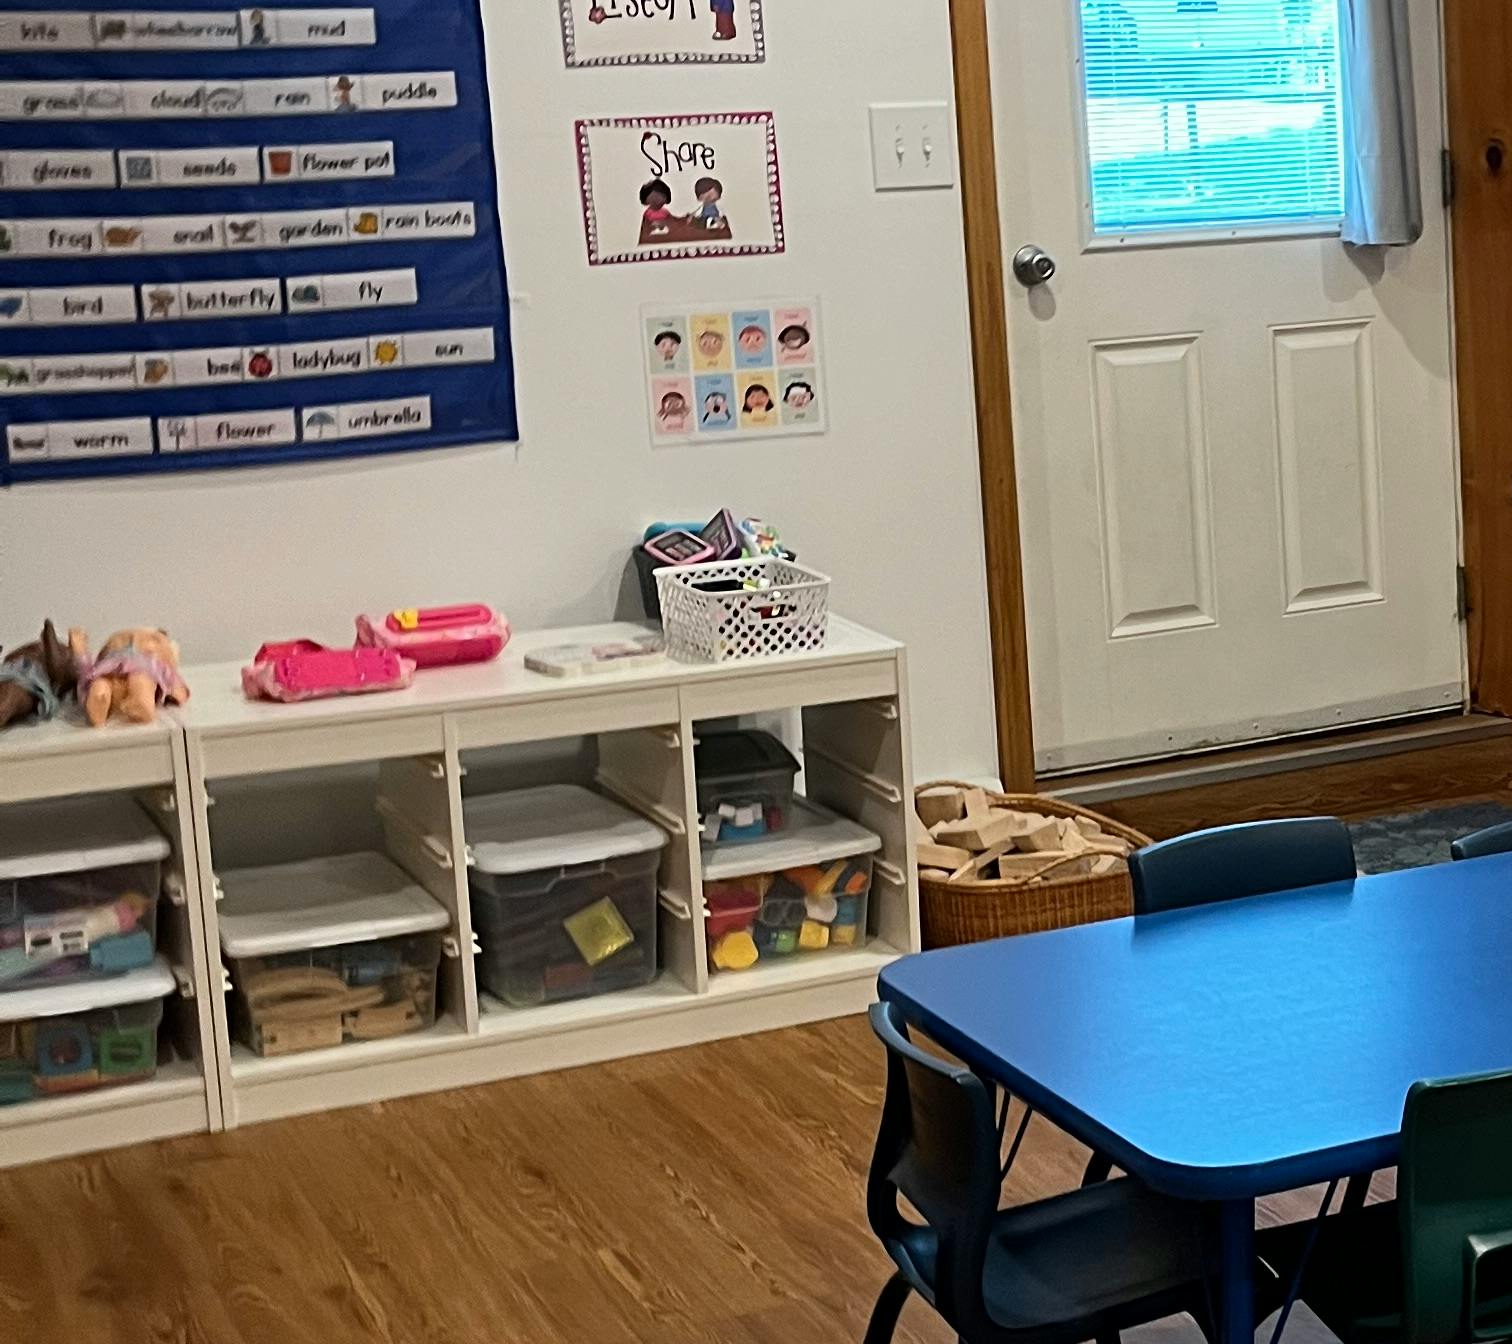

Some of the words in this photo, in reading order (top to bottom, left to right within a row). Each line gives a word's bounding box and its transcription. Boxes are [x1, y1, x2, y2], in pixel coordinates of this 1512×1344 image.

[638, 131, 716, 177] Share
[49, 229, 92, 252] frog
[279, 219, 343, 243] garden
[186, 287, 275, 310] butterfly
[358, 281, 383, 301] fly
[292, 348, 361, 371] ladybug
[348, 406, 422, 430] umbrella
[74, 433, 129, 449] worm
[215, 421, 276, 440] flower
